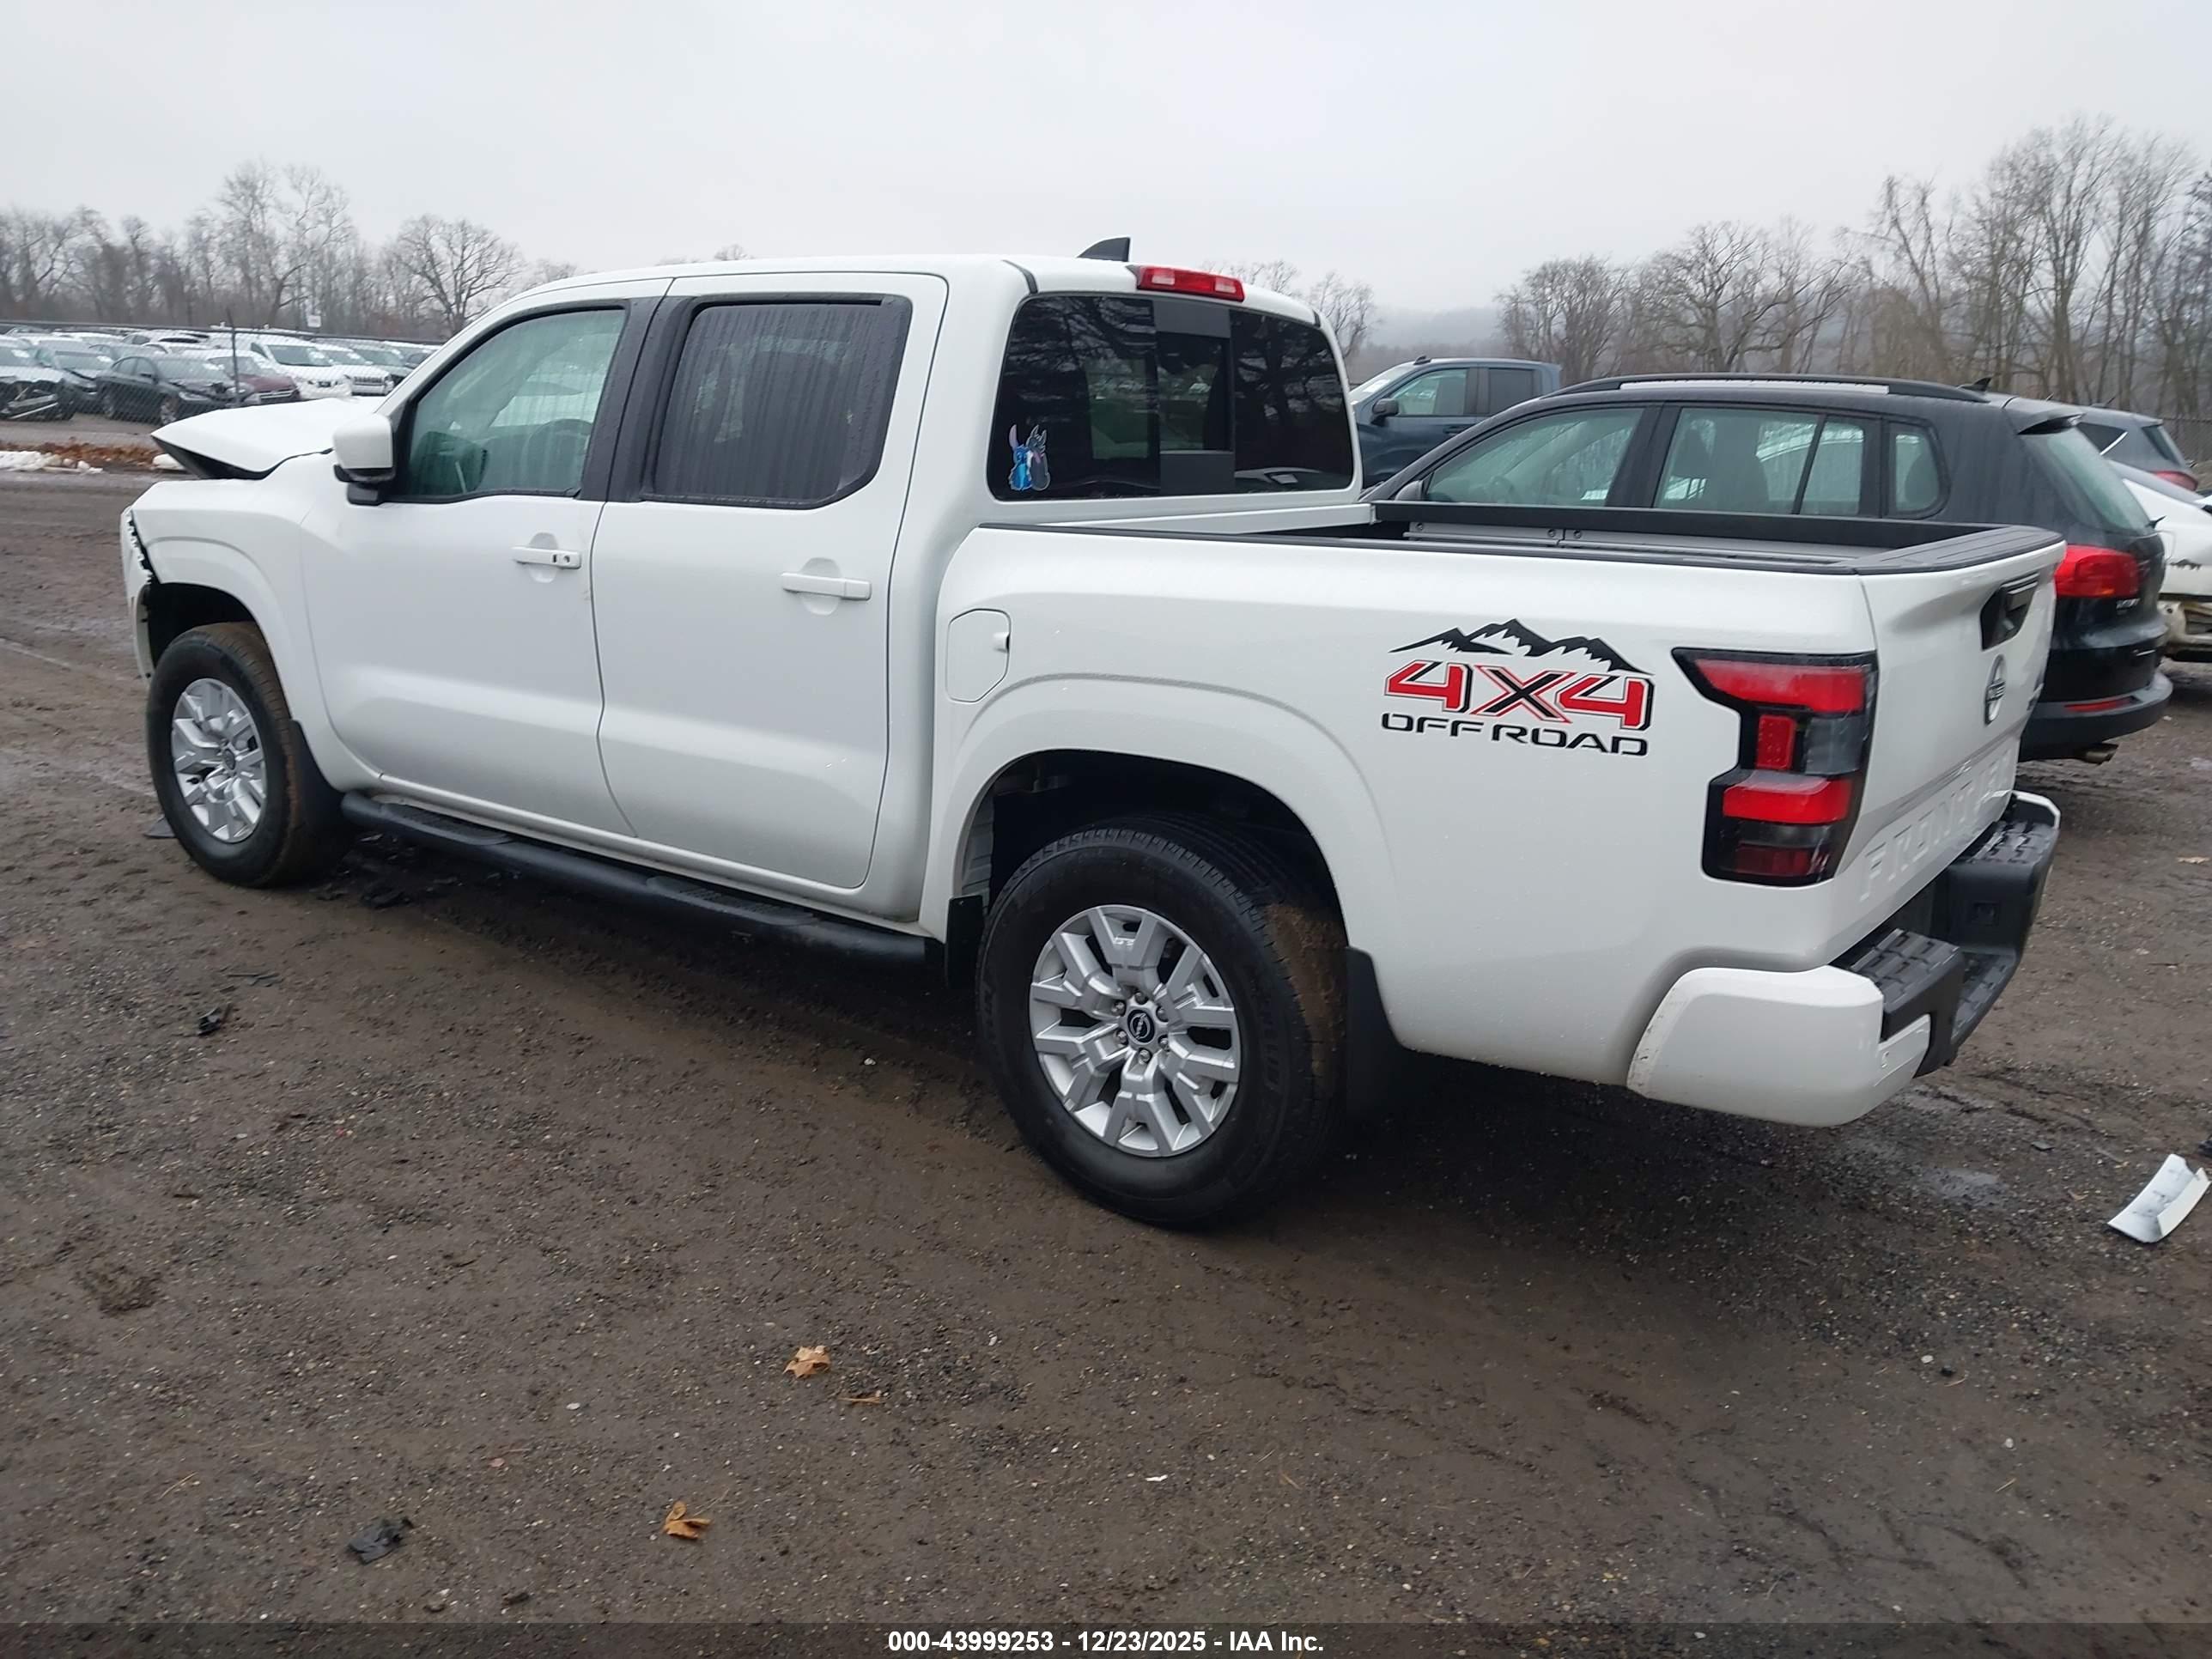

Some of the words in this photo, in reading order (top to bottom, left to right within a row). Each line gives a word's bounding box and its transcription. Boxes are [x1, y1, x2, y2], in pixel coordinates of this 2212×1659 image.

[1383, 659, 1656, 732] 4X4
[1381, 712, 1485, 738] OFF
[1491, 724, 1648, 757] ROAD
